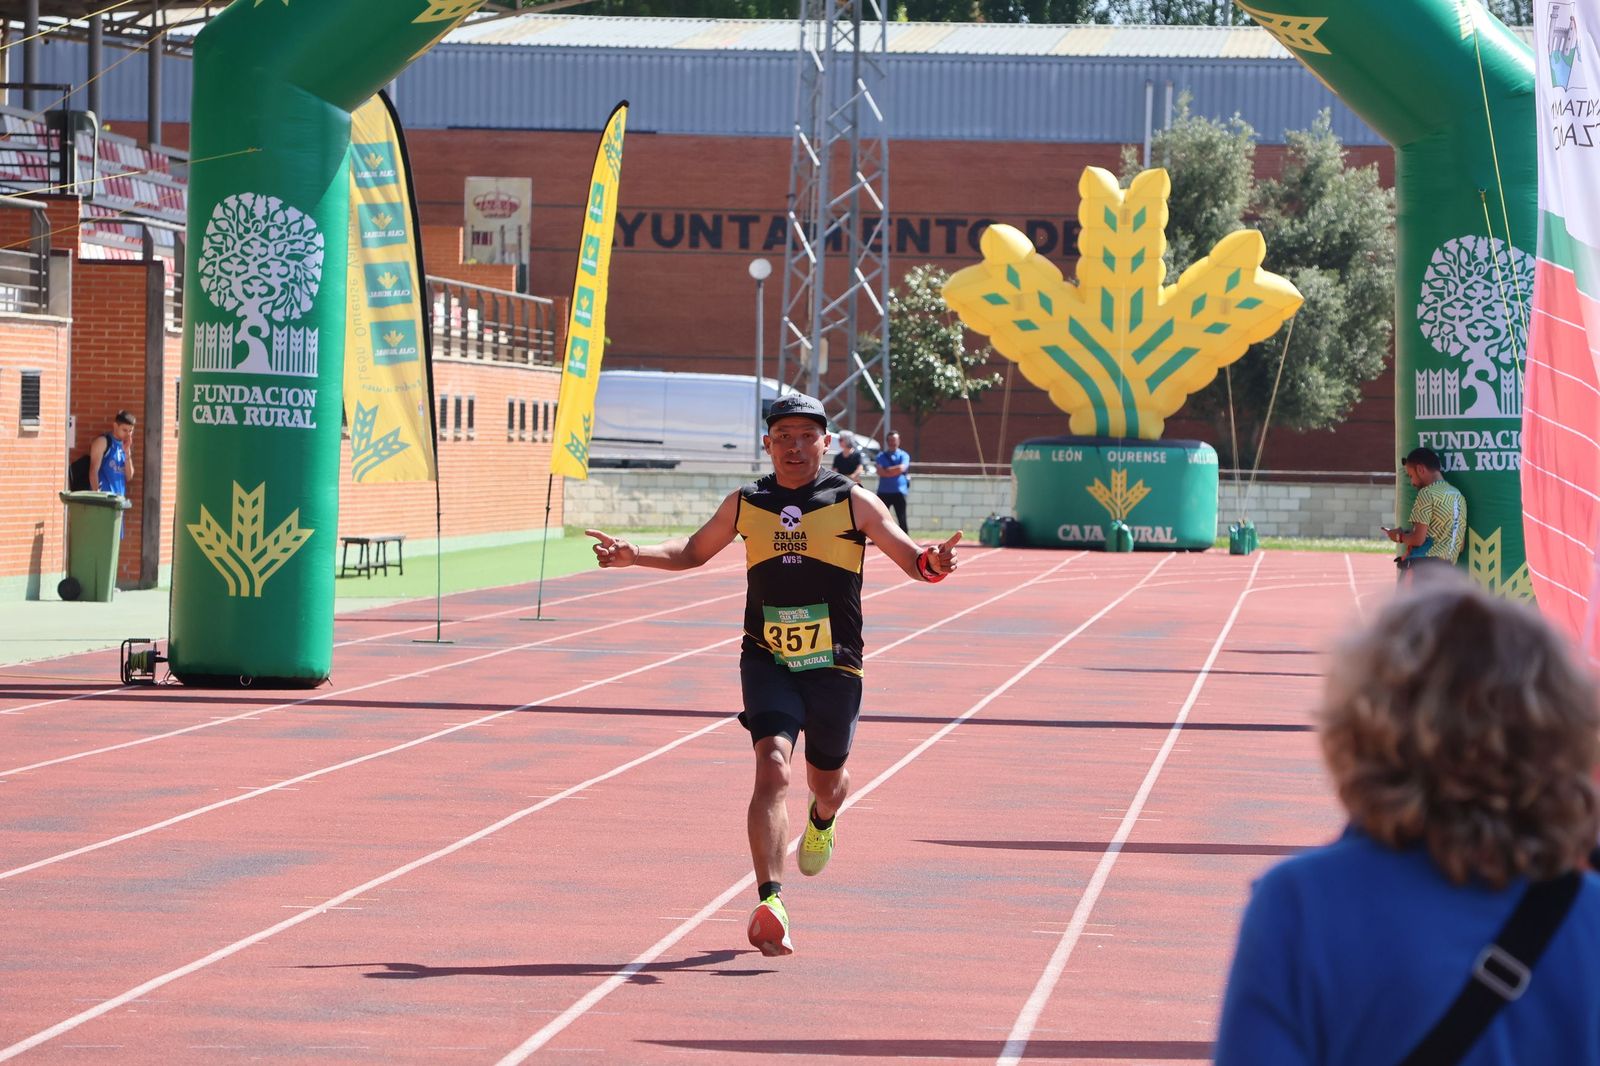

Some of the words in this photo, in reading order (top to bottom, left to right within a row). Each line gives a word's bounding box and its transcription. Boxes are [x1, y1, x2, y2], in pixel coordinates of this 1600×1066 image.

[192, 384, 318, 408] FUNDACION
[192, 405, 238, 426] CAJA
[243, 406, 317, 429] RURAL
[1417, 430, 1522, 450] FUNDACI
[1051, 448, 1083, 462] LEÓN
[1107, 451, 1167, 464] OURENSE
[1436, 451, 1470, 472] JA
[1058, 525, 1106, 542] CAJA
[1129, 526, 1178, 544] URAL
[773, 542, 808, 552] CROSS
[769, 623, 820, 652] 357
[803, 655, 830, 666] RURAL
